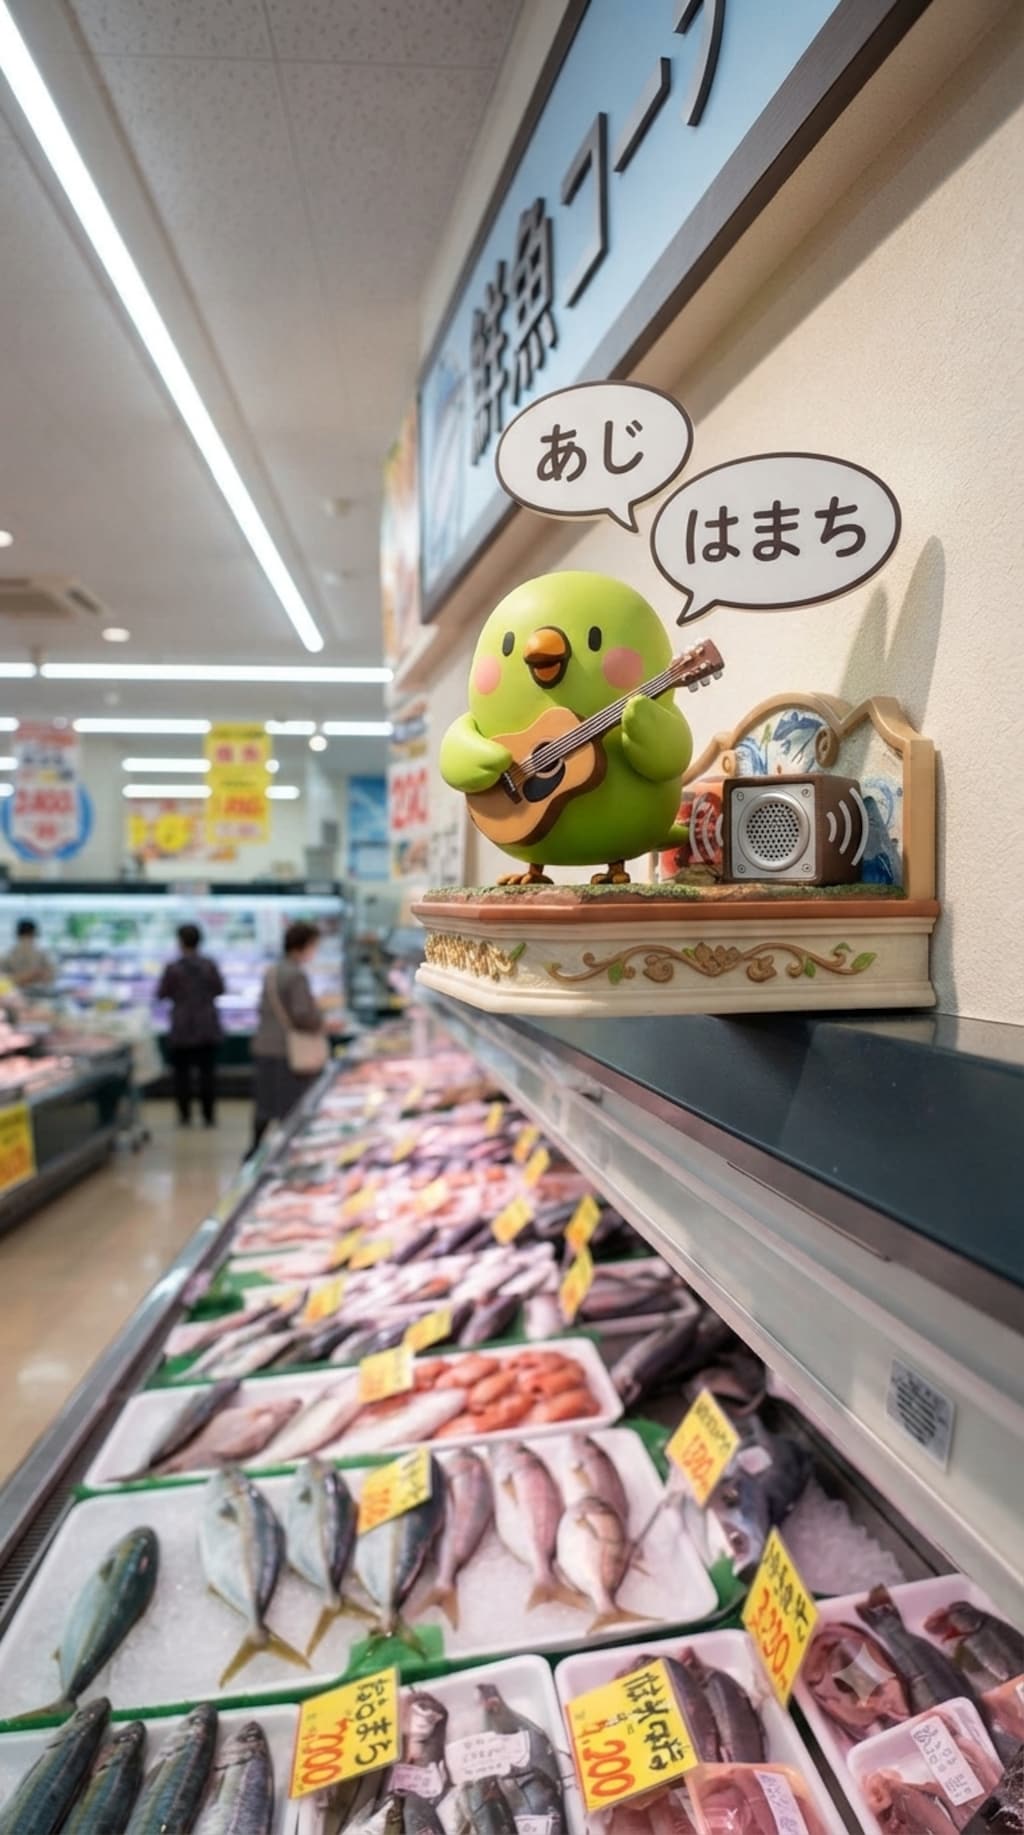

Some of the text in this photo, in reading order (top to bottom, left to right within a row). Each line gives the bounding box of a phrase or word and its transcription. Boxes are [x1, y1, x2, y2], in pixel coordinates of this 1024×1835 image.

[536, 419, 644, 483] あじ
[685, 496, 867, 565] はまち
